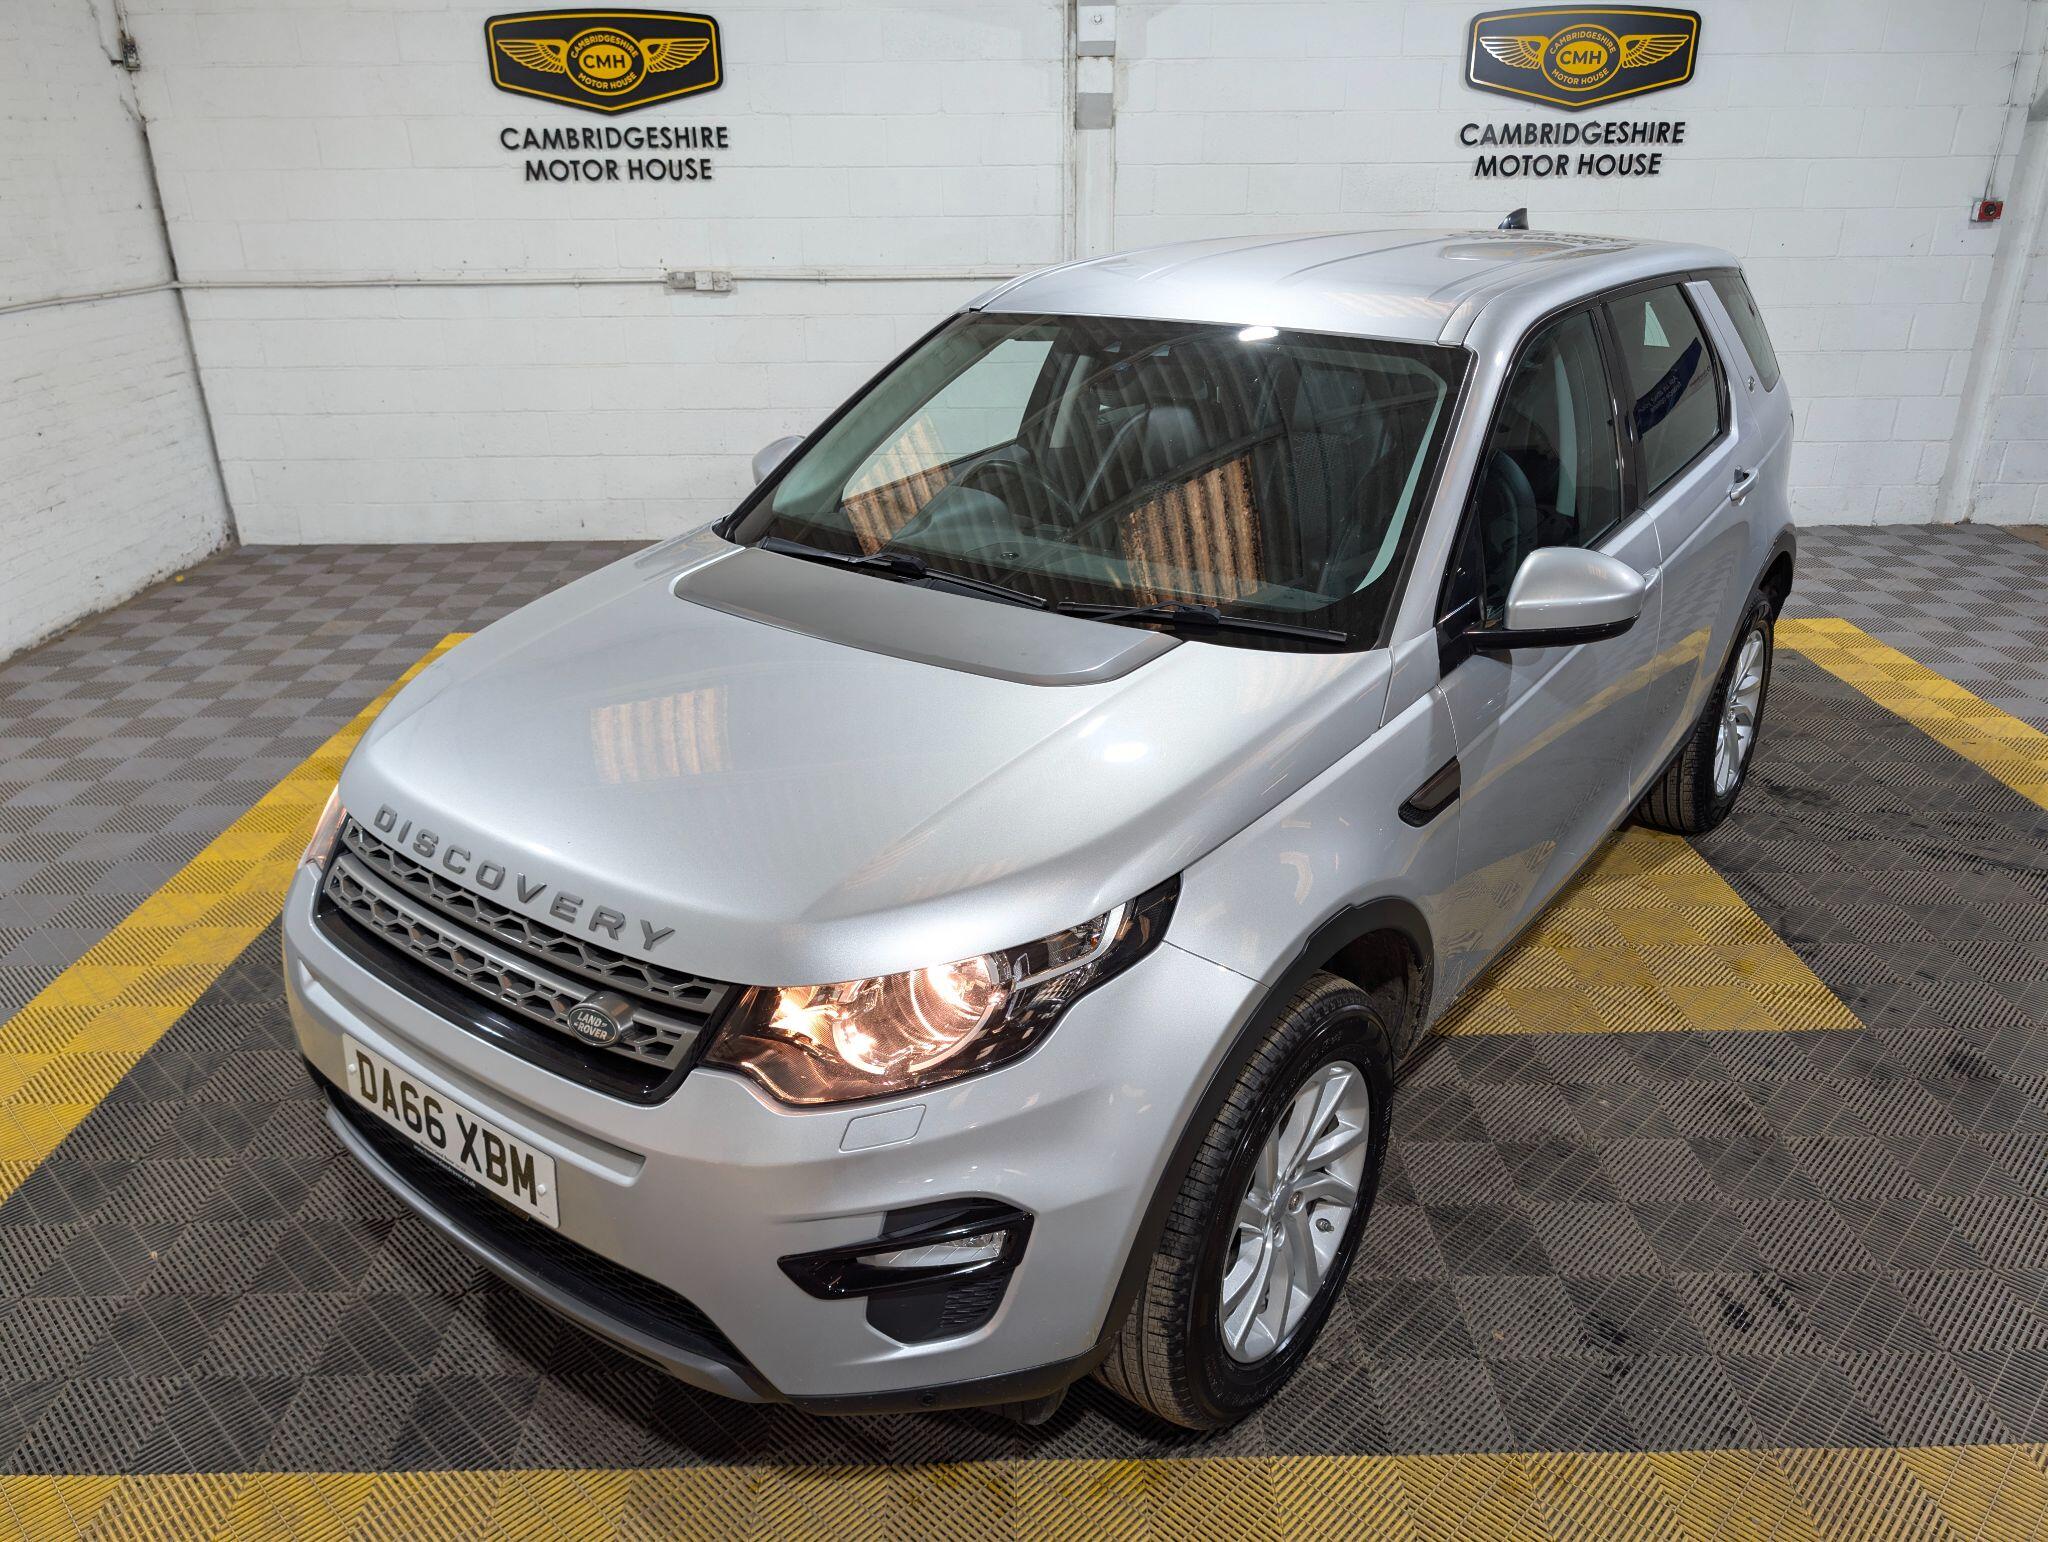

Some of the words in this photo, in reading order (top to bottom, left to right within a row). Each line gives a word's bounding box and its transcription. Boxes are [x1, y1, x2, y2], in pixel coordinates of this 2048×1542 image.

[570, 34, 639, 58] CAMBRIDGESHIRE
[1549, 31, 1617, 55] CAMBRIDGESHIRE
[582, 54, 626, 69] CMH
[1559, 50, 1602, 65] CMH
[577, 72, 609, 89] MOTOR
[610, 71, 638, 89] HOUSE
[1551, 68, 1579, 85] MOTOR
[1581, 67, 1610, 85] HOUSE
[500, 126, 730, 150] CAMBRIDGESHIRE
[1459, 121, 1687, 146] CAMBRIDGESHIRE
[525, 159, 619, 182] MOTOR
[627, 158, 713, 181] HOUSE
[1474, 154, 1569, 177] MOTOR
[1577, 153, 1664, 176] HOUSE
[373, 803, 676, 951] DISCOVERY
[577, 1011, 603, 1027] LAND
[577, 1022, 608, 1040] ROVER
[356, 1049, 447, 1149] DA66
[456, 1112, 538, 1207] XBM
